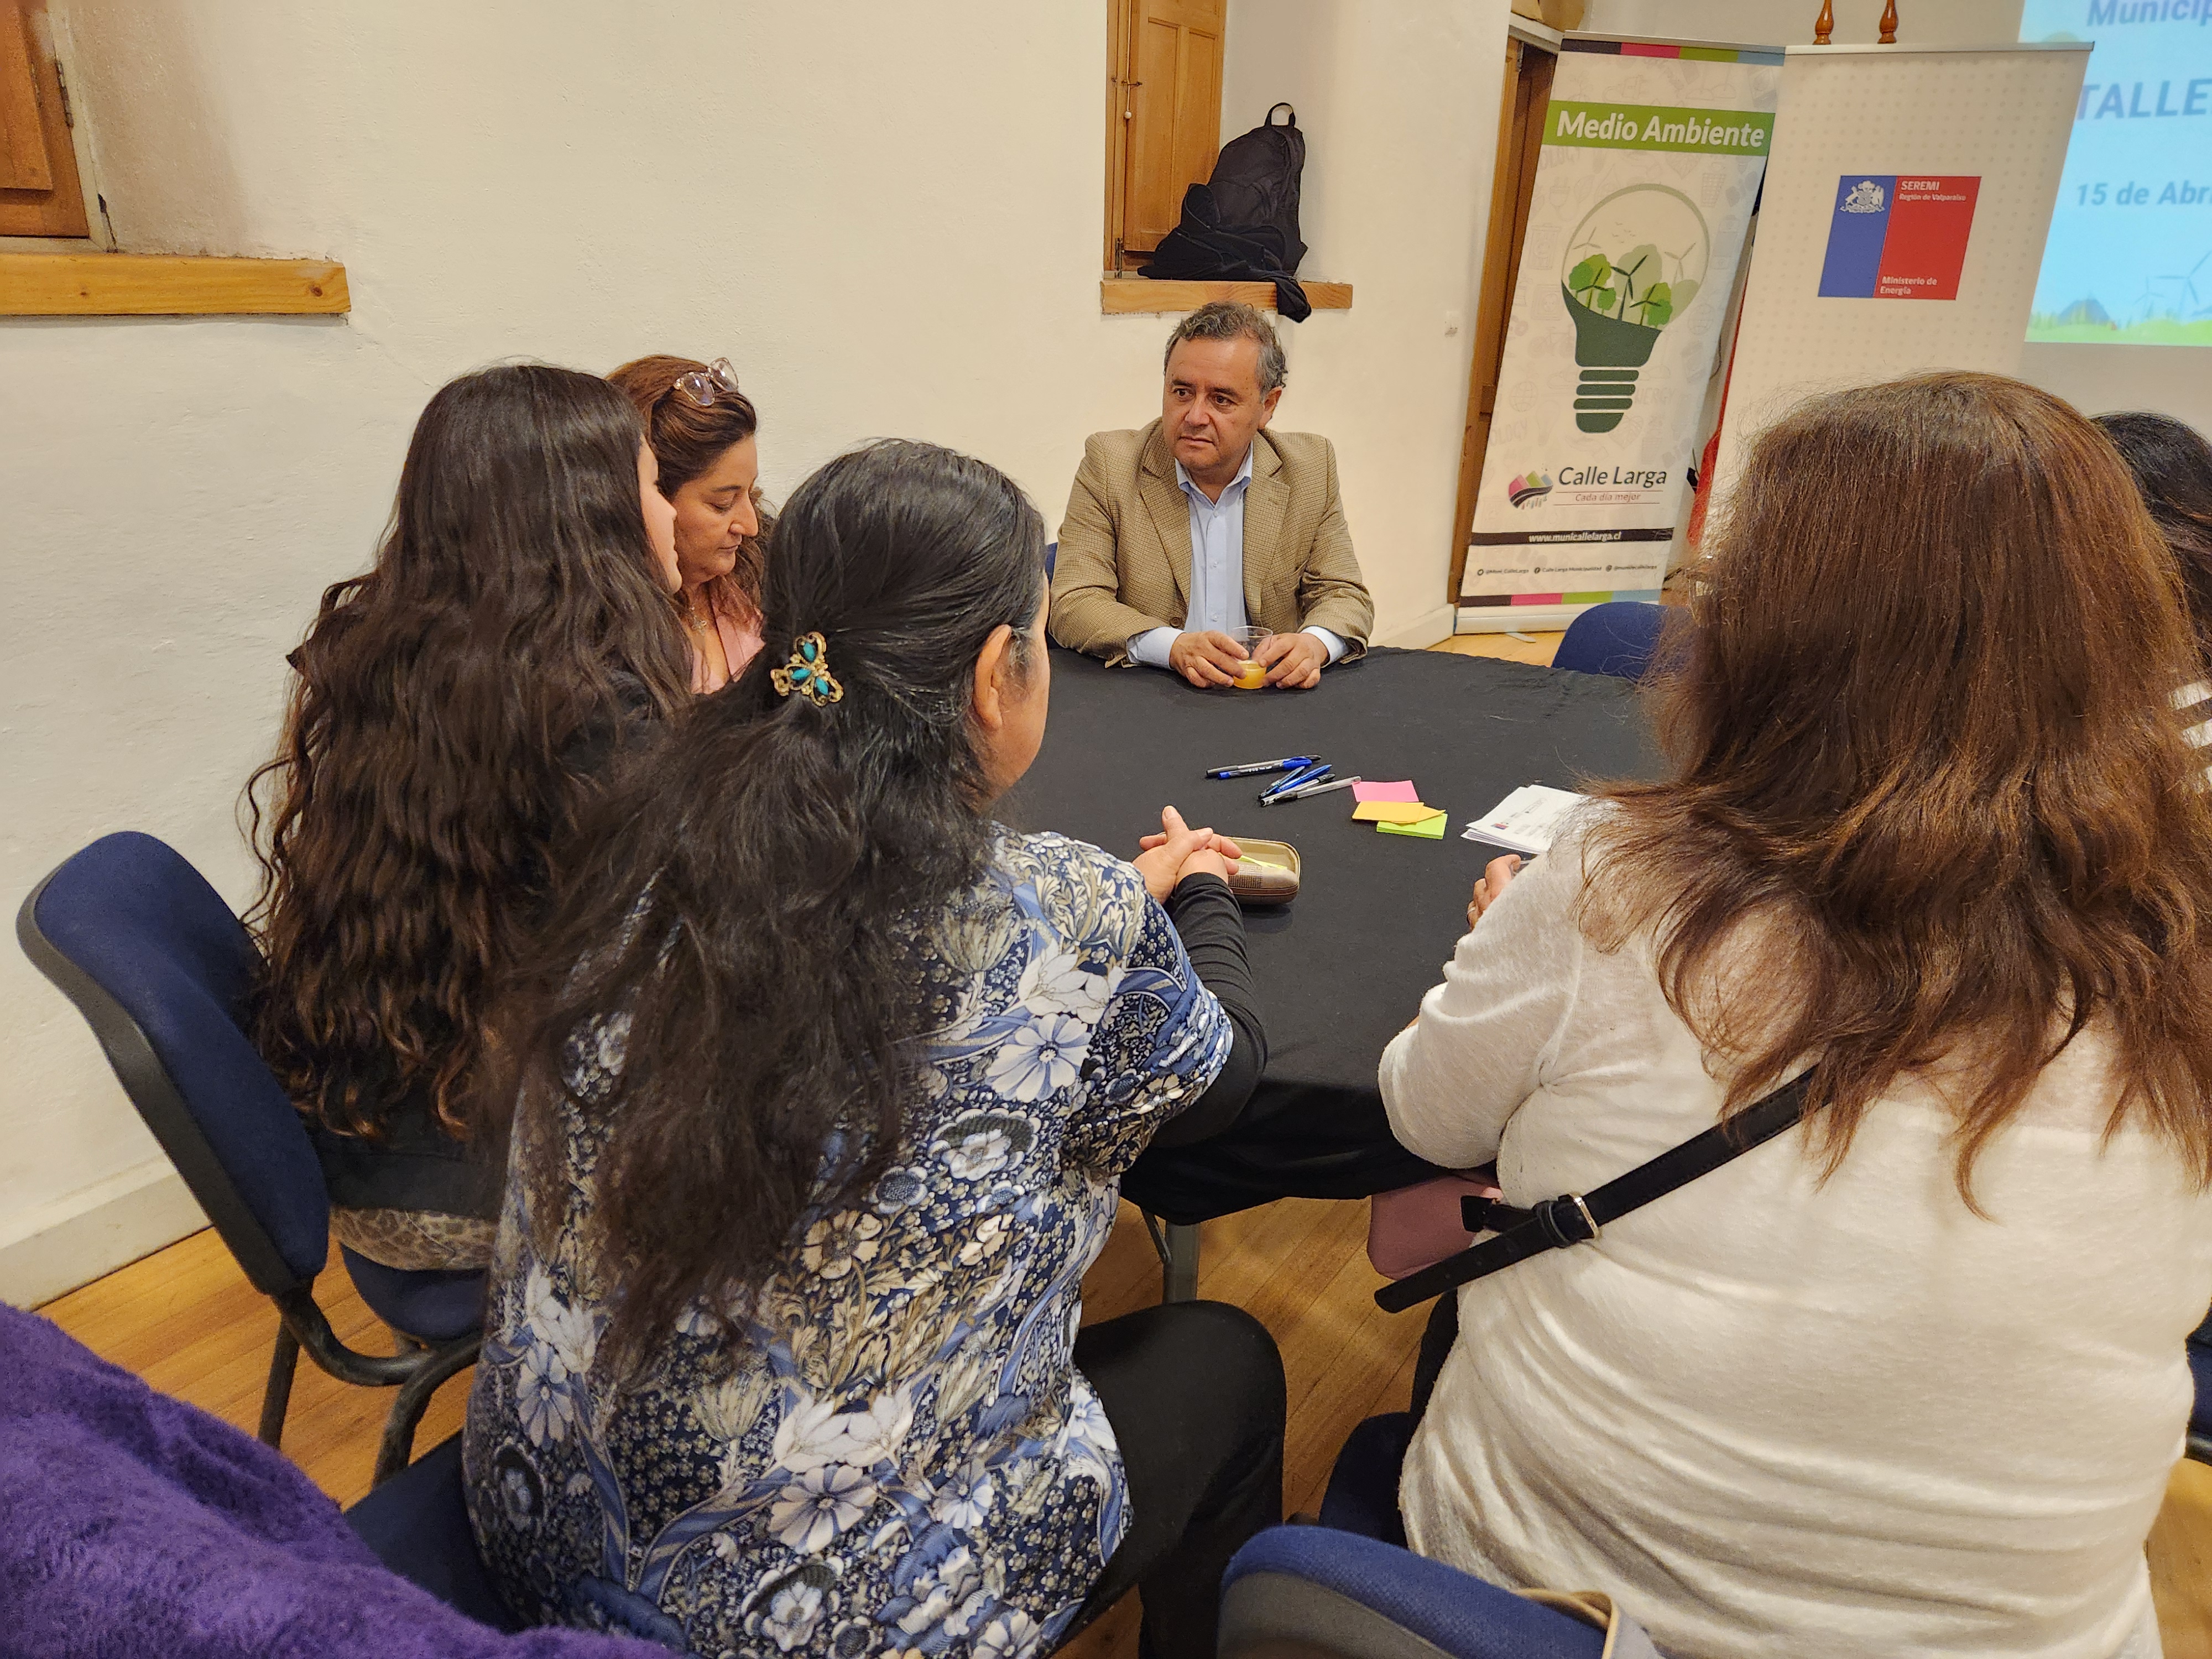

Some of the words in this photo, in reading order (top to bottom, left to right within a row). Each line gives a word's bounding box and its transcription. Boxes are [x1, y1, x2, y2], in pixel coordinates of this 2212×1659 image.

[2075, 78, 2212, 121] TALLE
[1557, 110, 1638, 140] Medio
[1641, 115, 1765, 147] Ambiente
[1901, 181, 1940, 191] SEREMI
[2078, 182, 2108, 206] 15
[2115, 181, 2150, 206] de
[1881, 276, 1925, 285] Ministerio
[1927, 277, 1937, 285] de
[1880, 286, 1912, 296] Energía
[1558, 466, 1609, 486] Calle
[1613, 466, 1667, 488] Larga
[1615, 493, 1641, 503] mejor
[1528, 531, 1622, 542] www.municallelarga.cl
